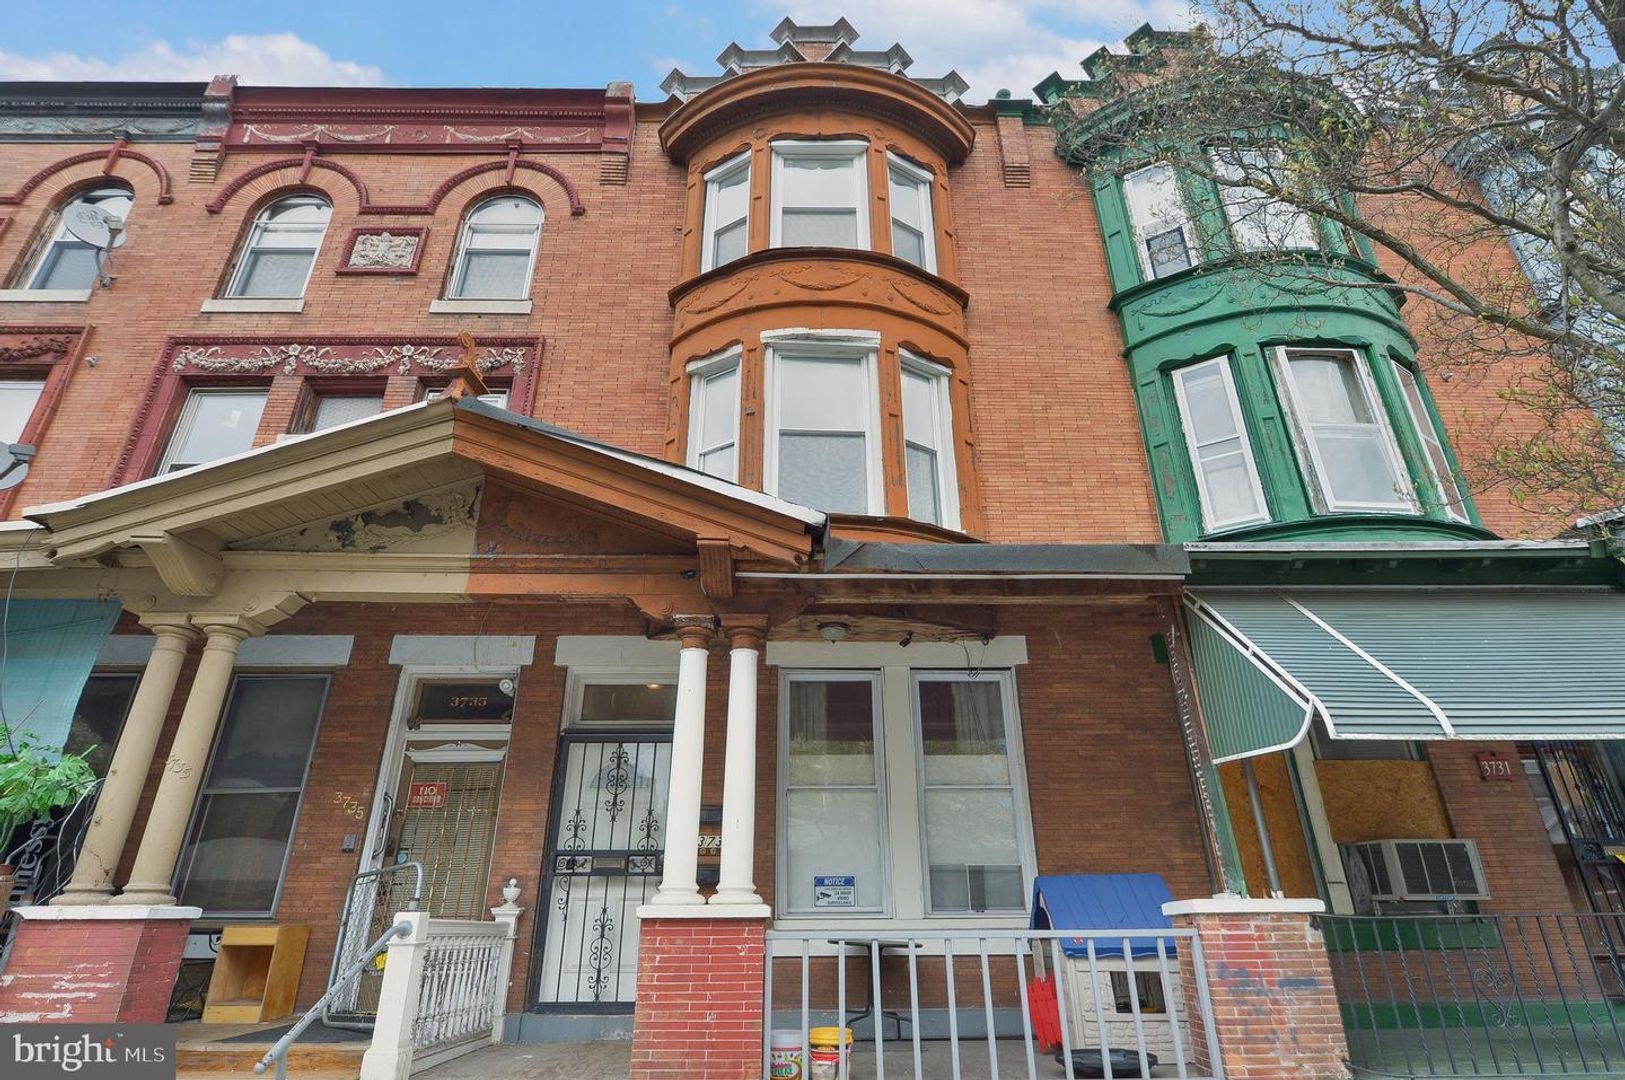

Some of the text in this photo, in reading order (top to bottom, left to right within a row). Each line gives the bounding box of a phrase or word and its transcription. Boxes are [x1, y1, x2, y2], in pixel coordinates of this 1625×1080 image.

[449, 696, 488, 708] 3735
[1481, 760, 1511, 776] 3731
[419, 786, 436, 796] NO
[333, 791, 365, 819] 3735
[823, 877, 846, 886] NOTICE
